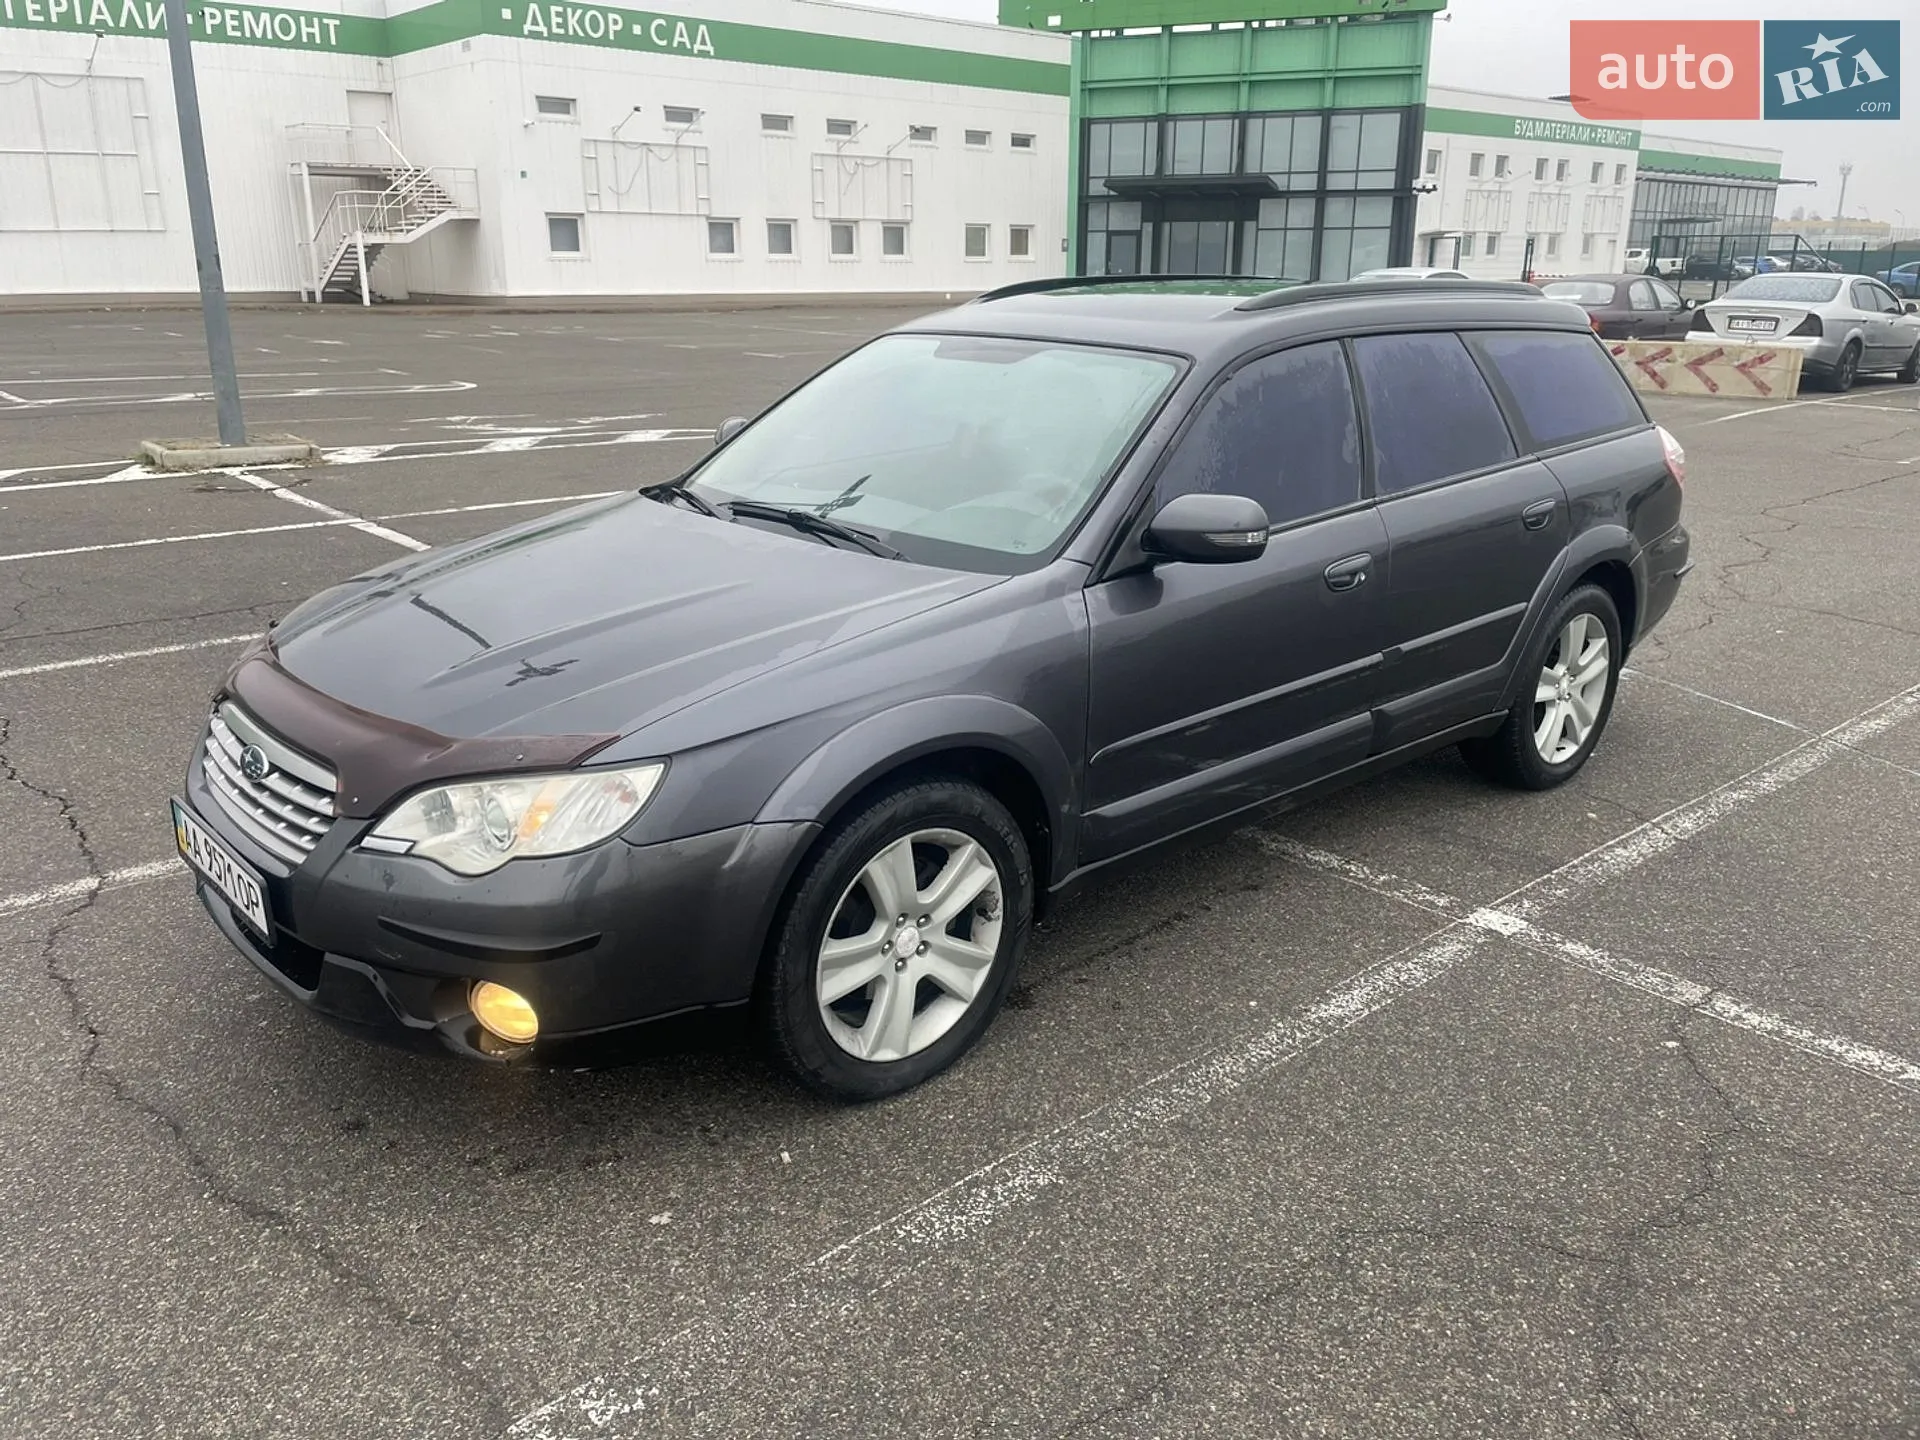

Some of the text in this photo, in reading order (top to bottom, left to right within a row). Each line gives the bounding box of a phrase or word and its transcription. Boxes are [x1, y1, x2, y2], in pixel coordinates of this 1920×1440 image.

[203, 6, 341, 46] РЕМОНТ
[522, 2, 715, 56] ДЕКОР САД
[1514, 118, 1633, 147] БУДМАТЕРІАЛИ РЕМОНТ
[237, 873, 260, 917] OP
